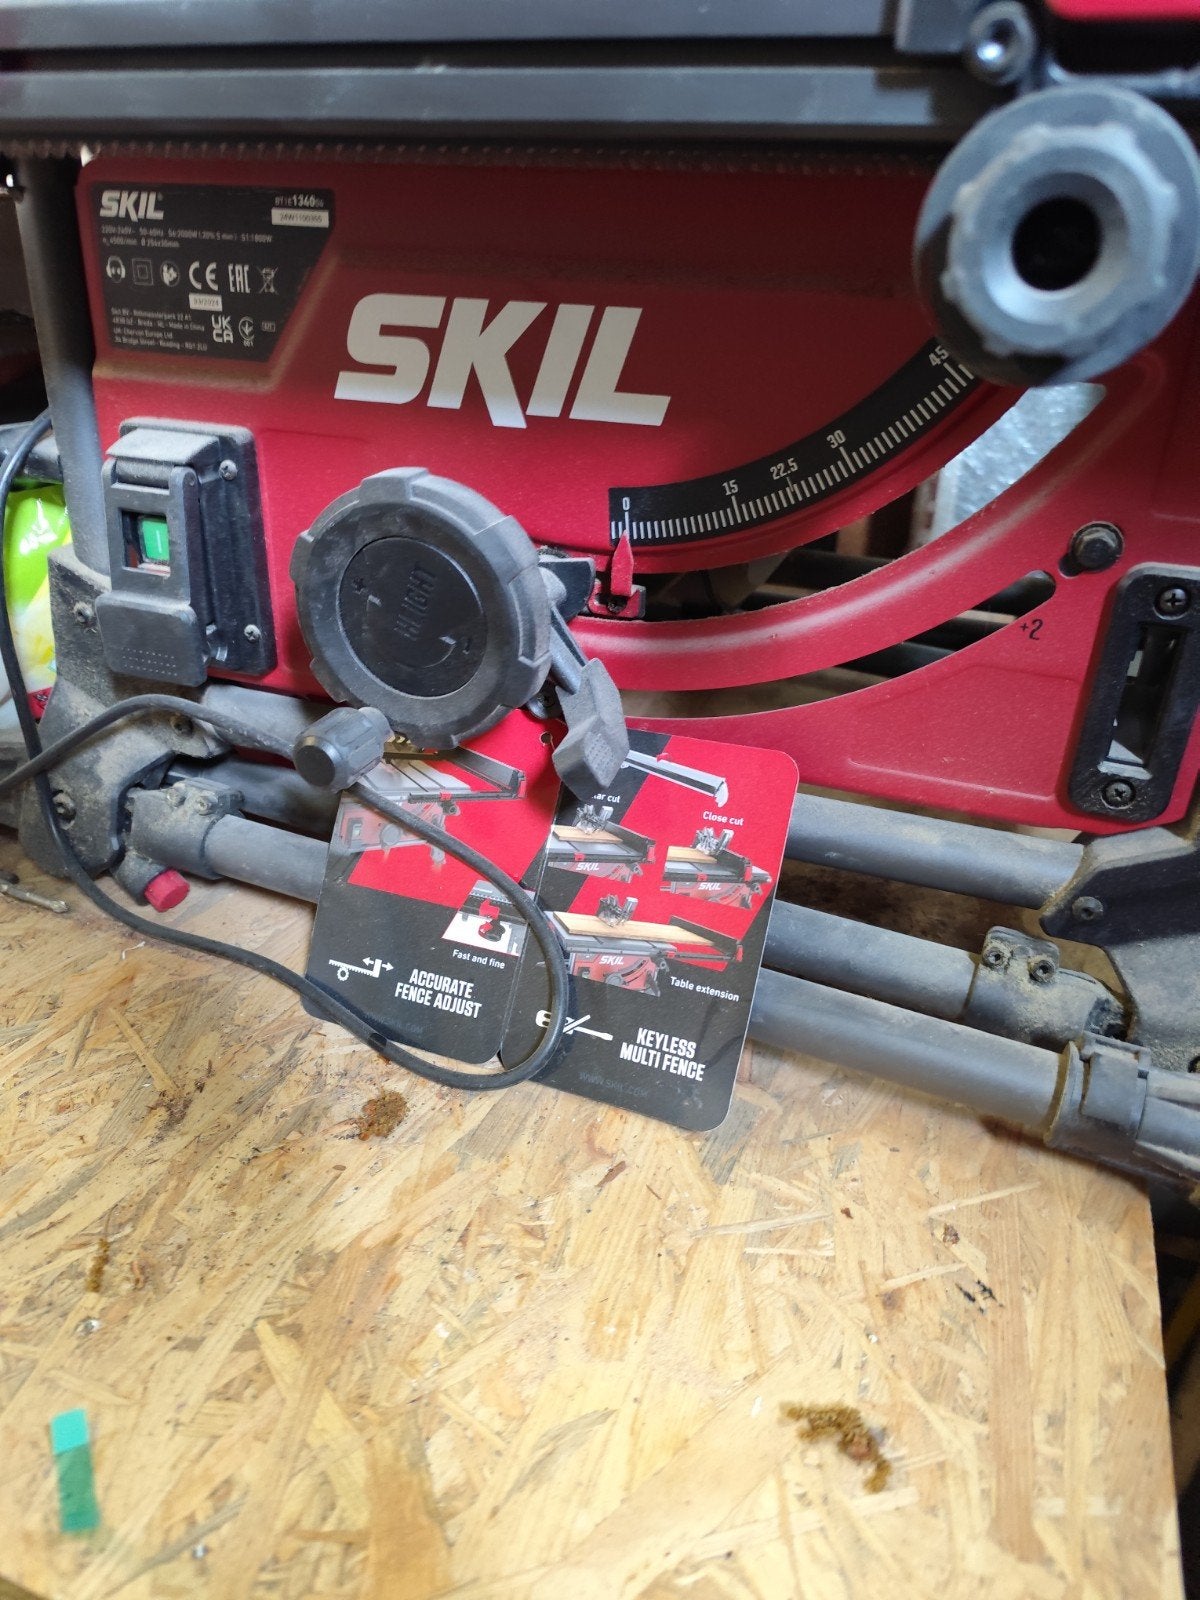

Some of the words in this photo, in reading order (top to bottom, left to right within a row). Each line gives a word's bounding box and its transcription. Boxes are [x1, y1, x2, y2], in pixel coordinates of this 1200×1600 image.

[100, 190, 164, 222] SKIL
[334, 293, 671, 428] SKIL
[928, 345, 950, 368] 45
[826, 429, 846, 449] 30
[769, 457, 799, 480] 22.5
[722, 479, 739, 496] 15
[622, 497, 631, 511] 0
[702, 810, 728, 824] Close
[729, 816, 744, 827] cut
[576, 862, 600, 871] SKIL
[698, 882, 721, 891] SKIL
[452, 949, 470, 961] Fast
[471, 953, 487, 964] and
[488, 955, 506, 969] fine
[599, 955, 624, 965] SKIL
[409, 968, 475, 999] ACCURATE
[670, 976, 694, 991] Table
[695, 984, 740, 1002] extension
[395, 982, 432, 1006] FENCE
[433, 993, 482, 1019] ADJUST
[636, 1027, 697, 1059] KEYLESS
[619, 1042, 661, 1069] MULTI
[661, 1053, 706, 1082] FENCE
